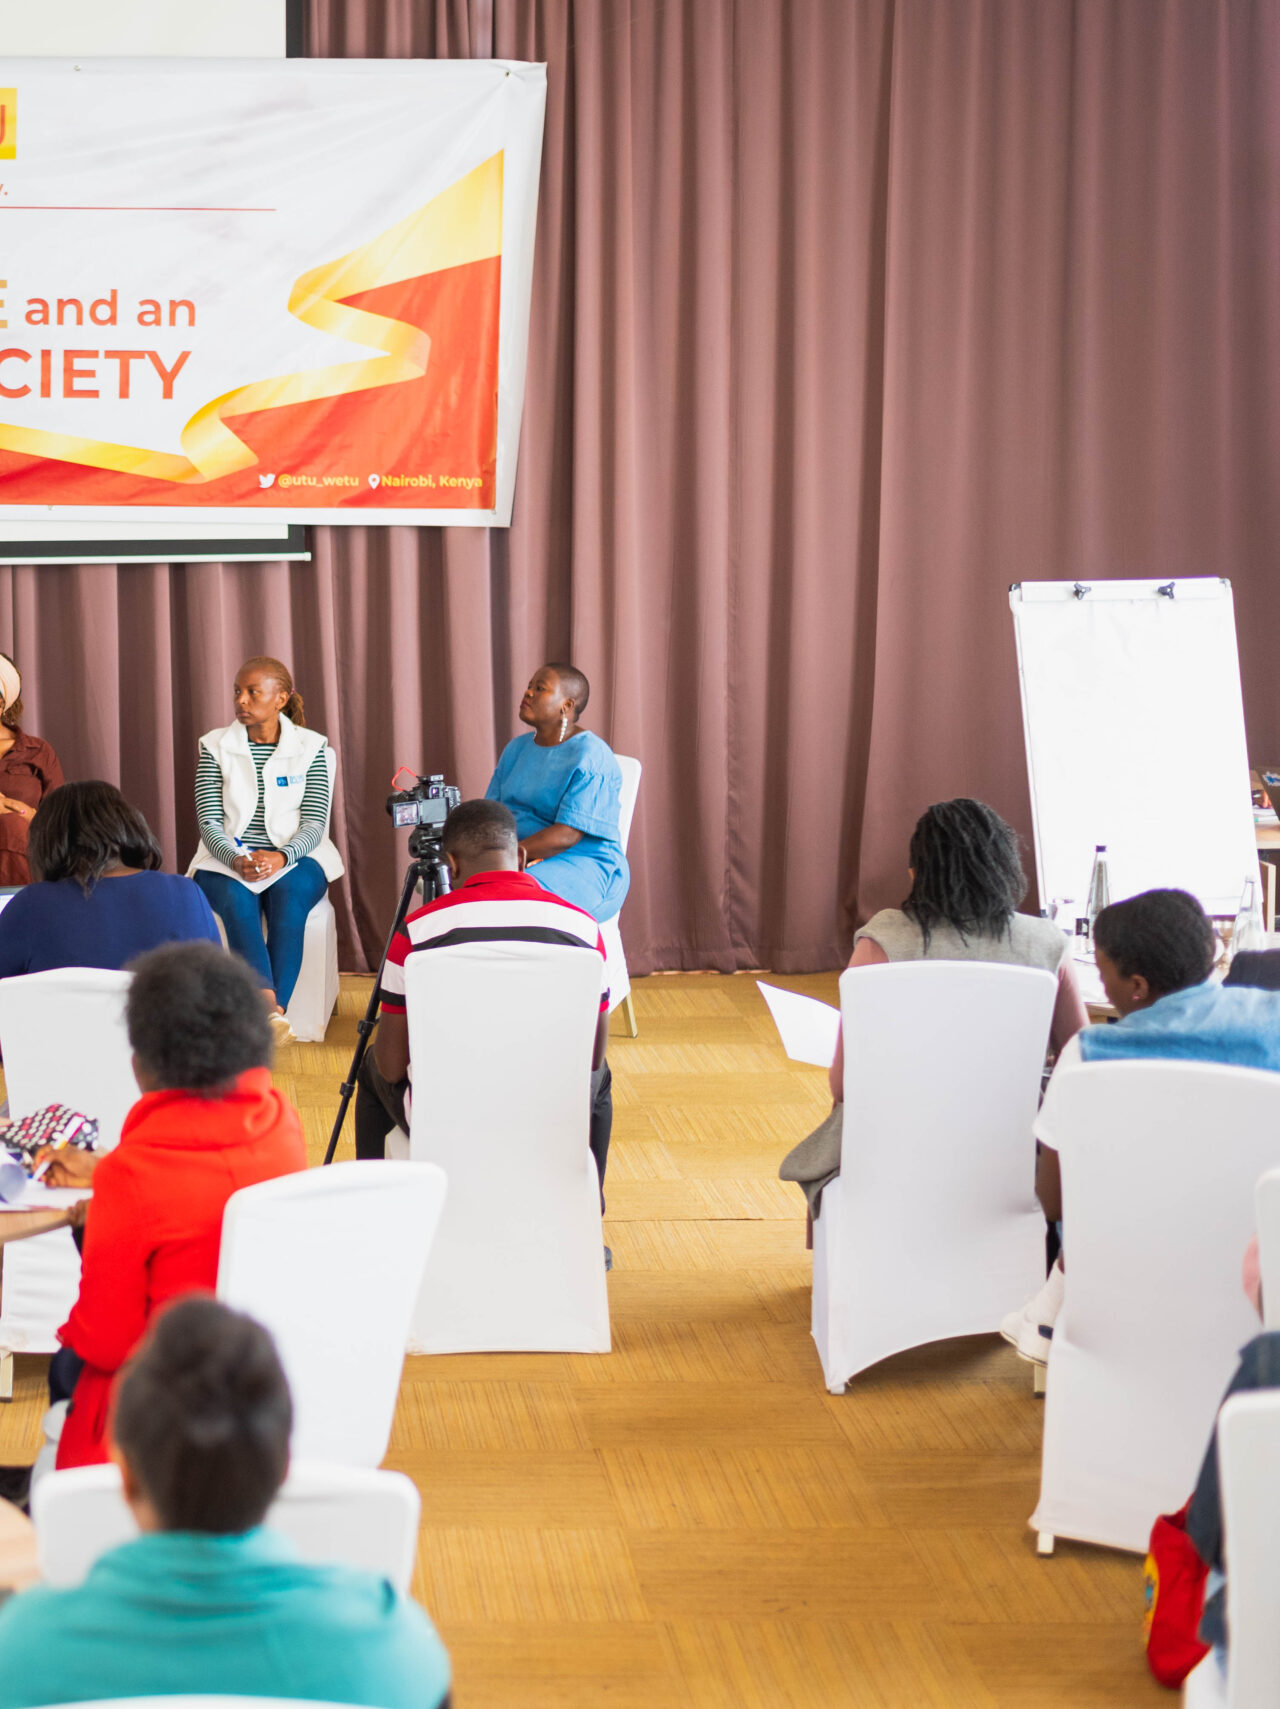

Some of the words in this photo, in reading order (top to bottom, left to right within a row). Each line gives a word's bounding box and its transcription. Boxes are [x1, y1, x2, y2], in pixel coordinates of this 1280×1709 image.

[24, 288, 118, 327] and
[136, 298, 196, 327] an
[278, 474, 359, 489] @utu_wetu
[381, 474, 436, 489] Nairobi,
[439, 475, 483, 490] Kenya
